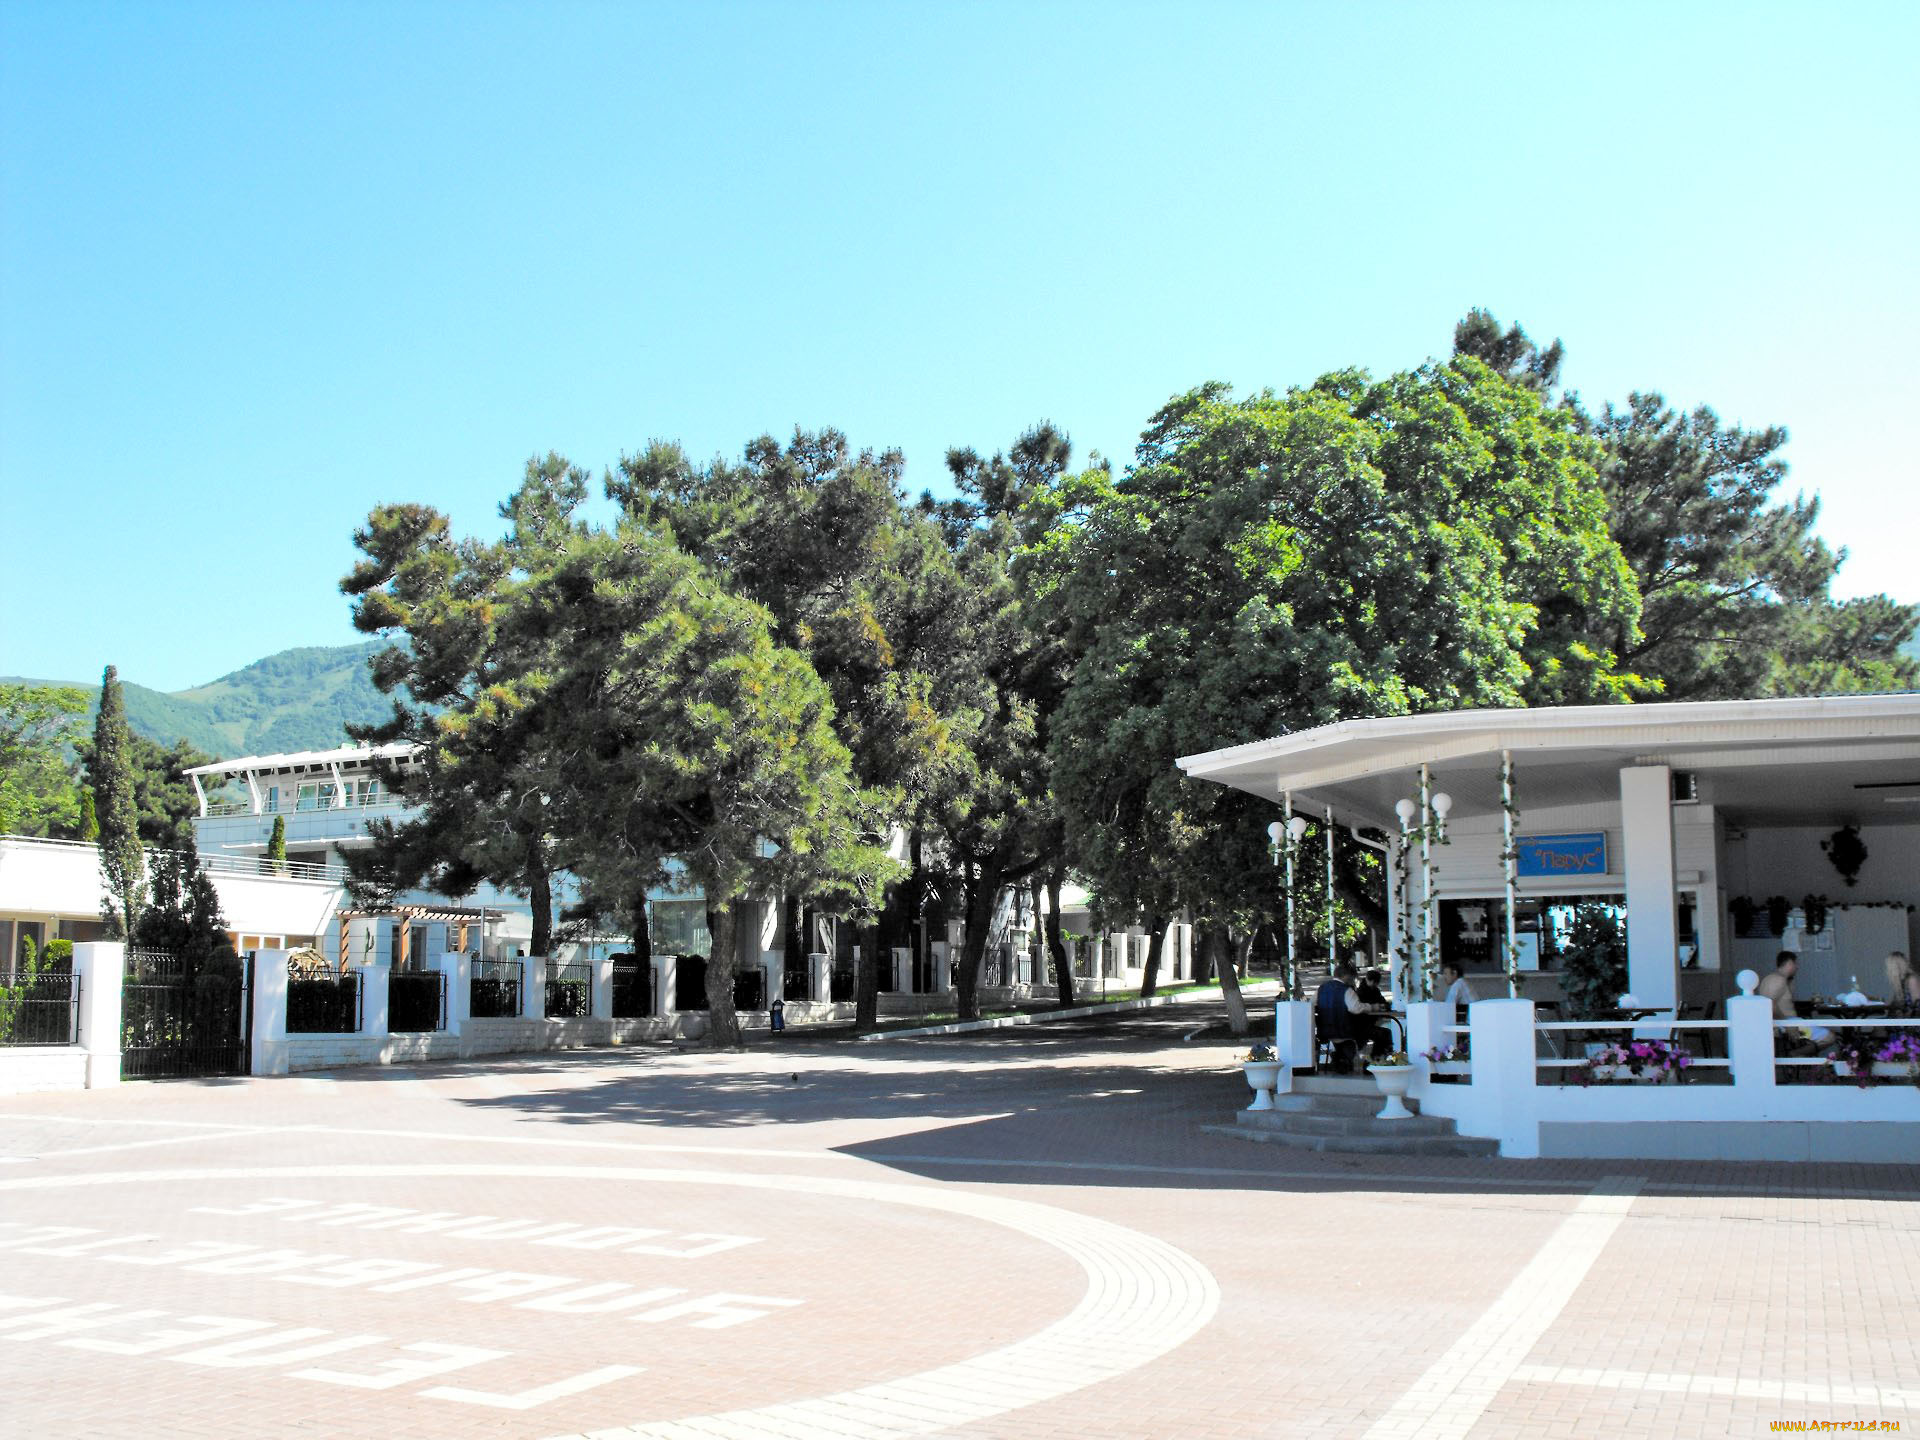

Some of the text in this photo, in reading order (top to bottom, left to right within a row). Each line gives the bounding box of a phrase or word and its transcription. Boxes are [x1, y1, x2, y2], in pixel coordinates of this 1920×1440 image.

[0, 1222, 807, 1329] УЛЫБАЕТС
[187, 1197, 767, 1259] СОЛНЦЕ
[0, 1296, 649, 1410] ГЕЛЕН
